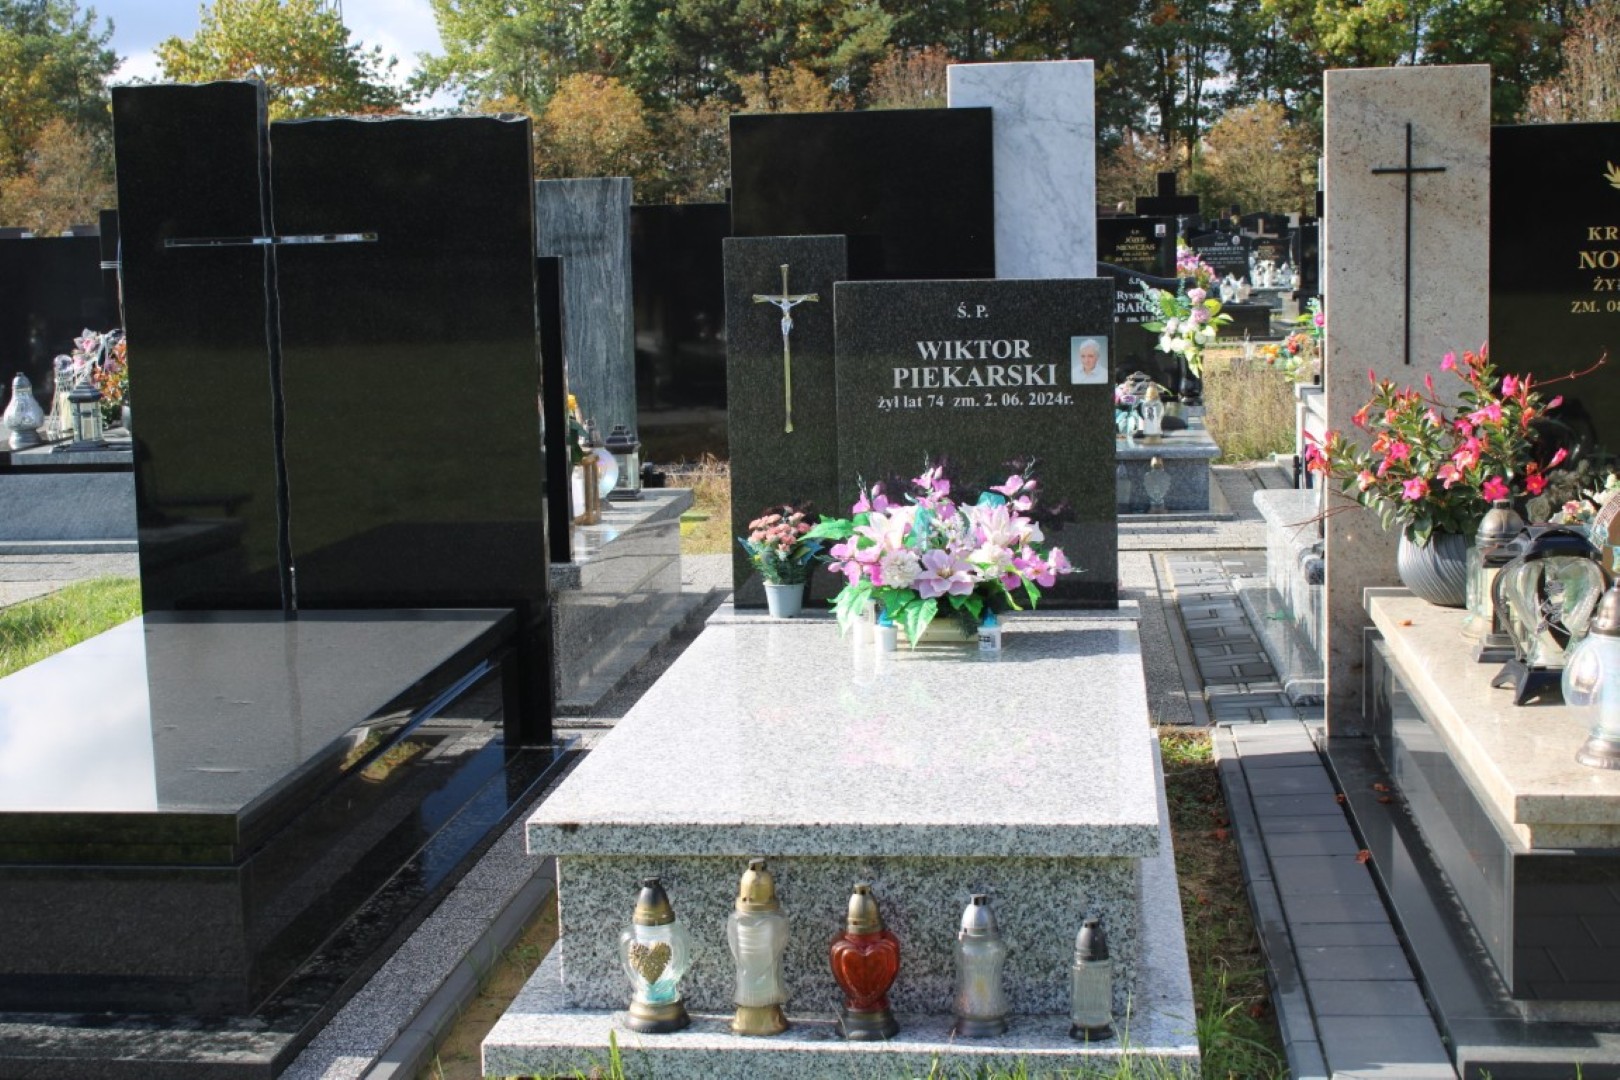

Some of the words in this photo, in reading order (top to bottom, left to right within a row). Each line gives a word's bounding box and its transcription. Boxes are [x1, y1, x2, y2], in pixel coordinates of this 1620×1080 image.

[1578, 250, 1620, 269] NO
[957, 301, 971, 319] Ś.
[976, 304, 989, 318] P.
[1570, 300, 1601, 314] ZM.
[916, 339, 1032, 361] WIKTOR
[893, 363, 1057, 389] PIEKARSKI
[878, 395, 899, 412] żył
[903, 395, 922, 409] lat
[927, 394, 945, 408] 74
[953, 396, 980, 408] zm.
[984, 393, 998, 407] 2.
[1001, 392, 1024, 407] 06.
[1028, 391, 1074, 406] 2024r.
